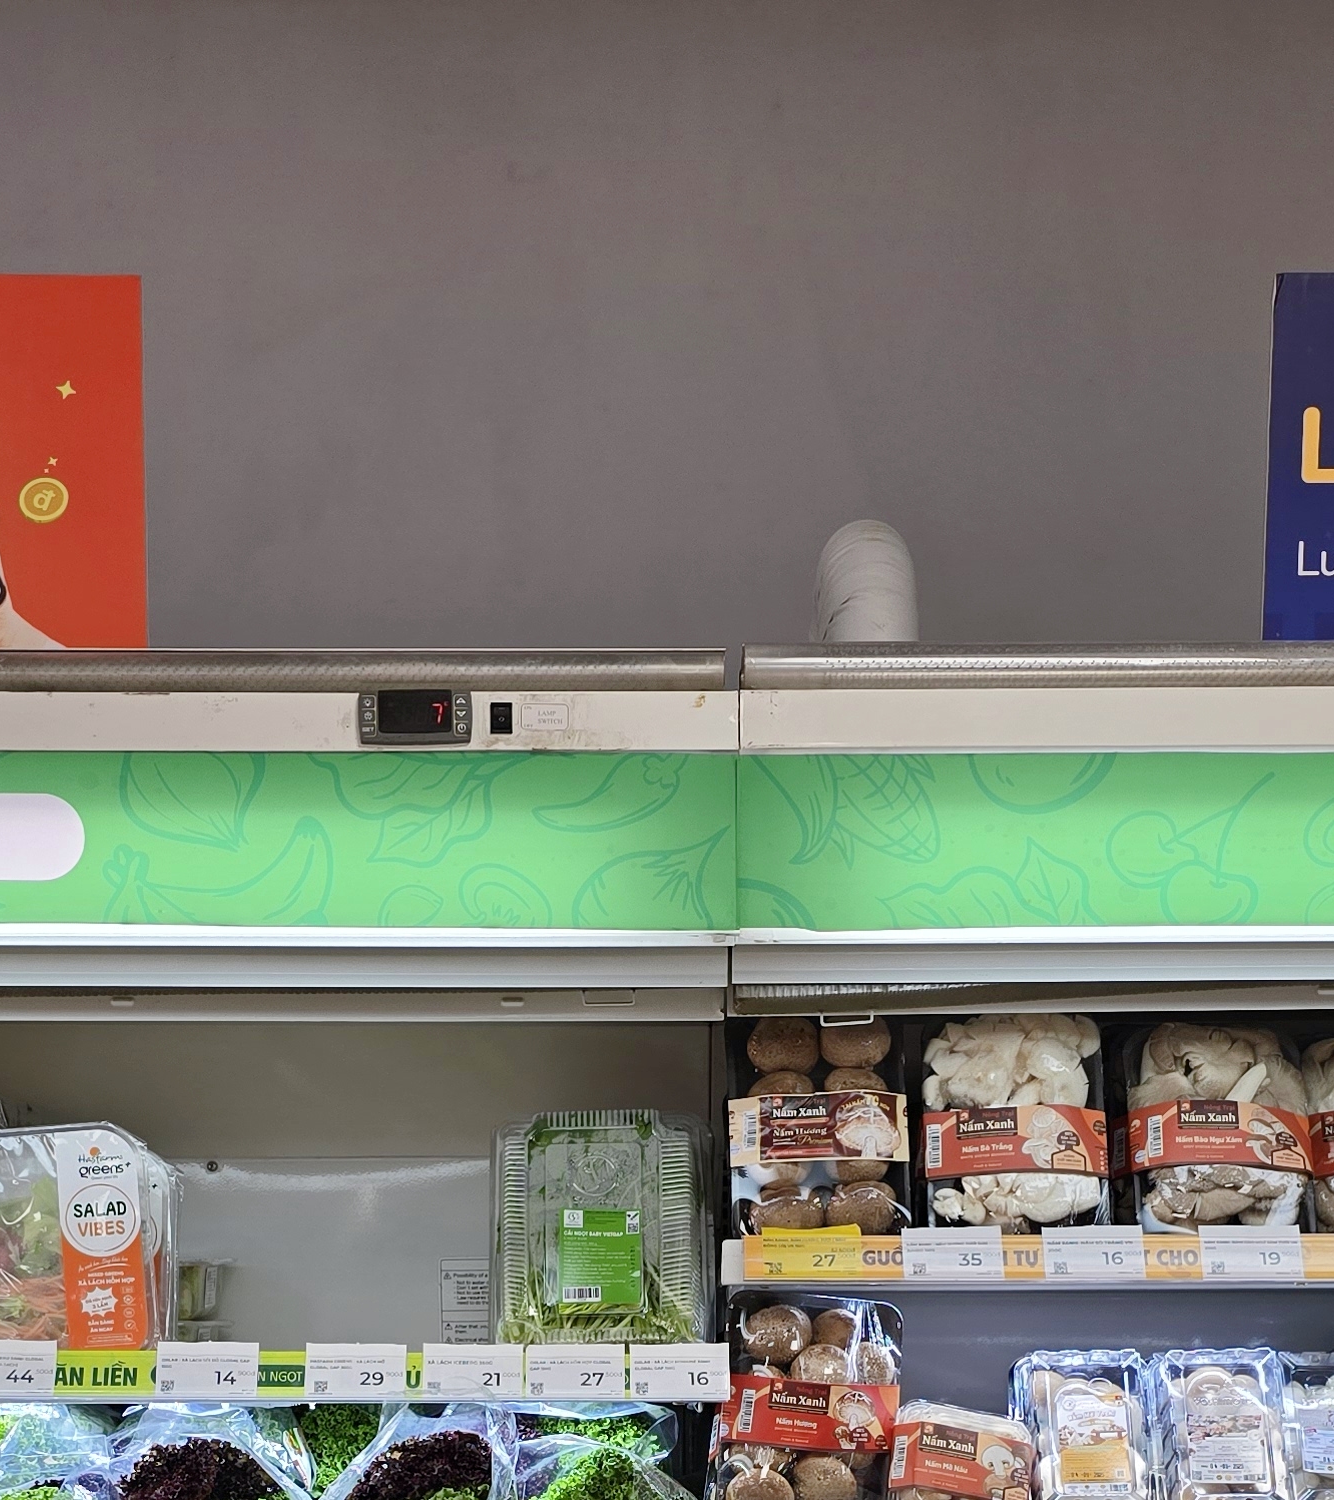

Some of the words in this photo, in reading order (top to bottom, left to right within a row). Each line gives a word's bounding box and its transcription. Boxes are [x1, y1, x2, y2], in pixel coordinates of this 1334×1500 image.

[537, 709, 557, 717] LAMP
[537, 718, 564, 726] SWITCH
[959, 1121, 983, 1133] Nấm
[985, 1118, 1016, 1131] Xanh
[73, 1200, 127, 1218] SALAD
[77, 1220, 126, 1237] VIBES
[6, 1370, 34, 1383] 44
[55, 1360, 85, 1386] ĂN
[92, 1360, 137, 1387] LIỀN
[215, 1371, 236, 1385] 14
[581, 1373, 604, 1386] 27
[923, 1435, 947, 1448] Nấm
[948, 1442, 975, 1455] Xanh
